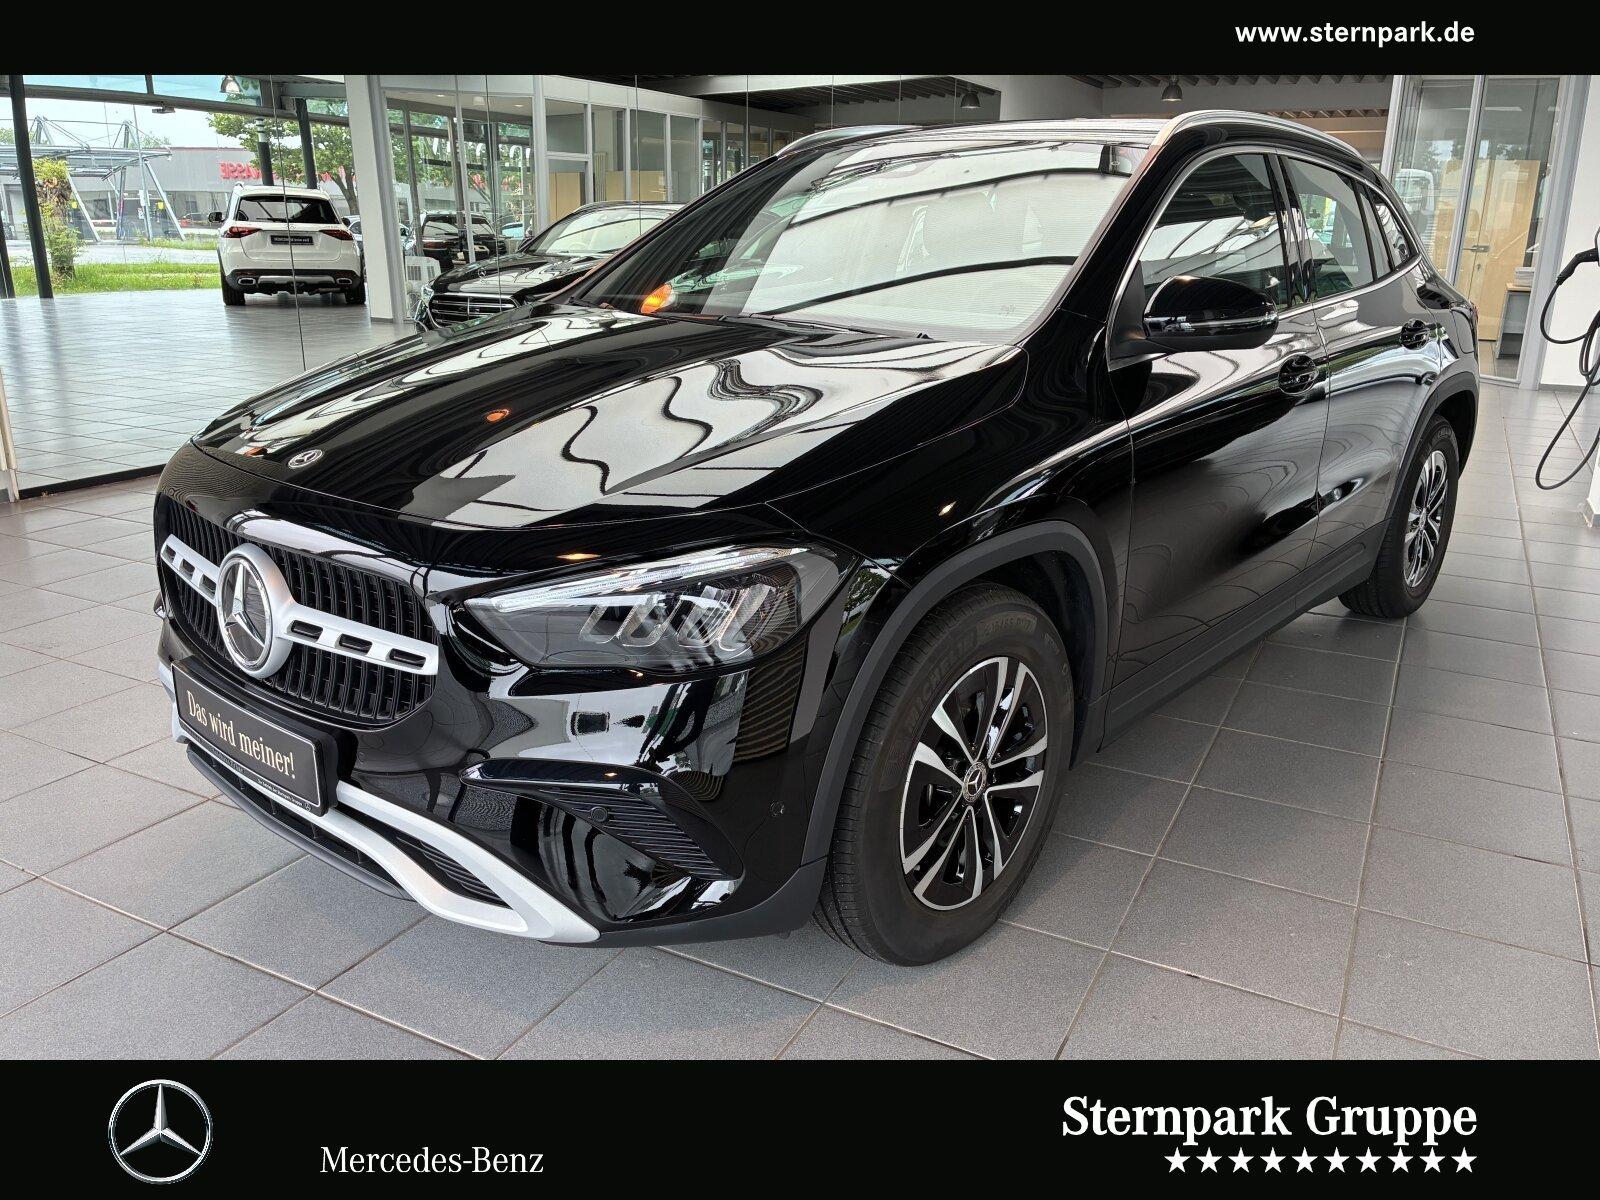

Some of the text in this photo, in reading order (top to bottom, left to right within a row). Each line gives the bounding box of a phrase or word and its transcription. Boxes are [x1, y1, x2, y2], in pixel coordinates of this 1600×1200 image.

[186, 689, 208, 727] Das
[208, 712, 237, 747] wird
[238, 732, 296, 780] meiner!
